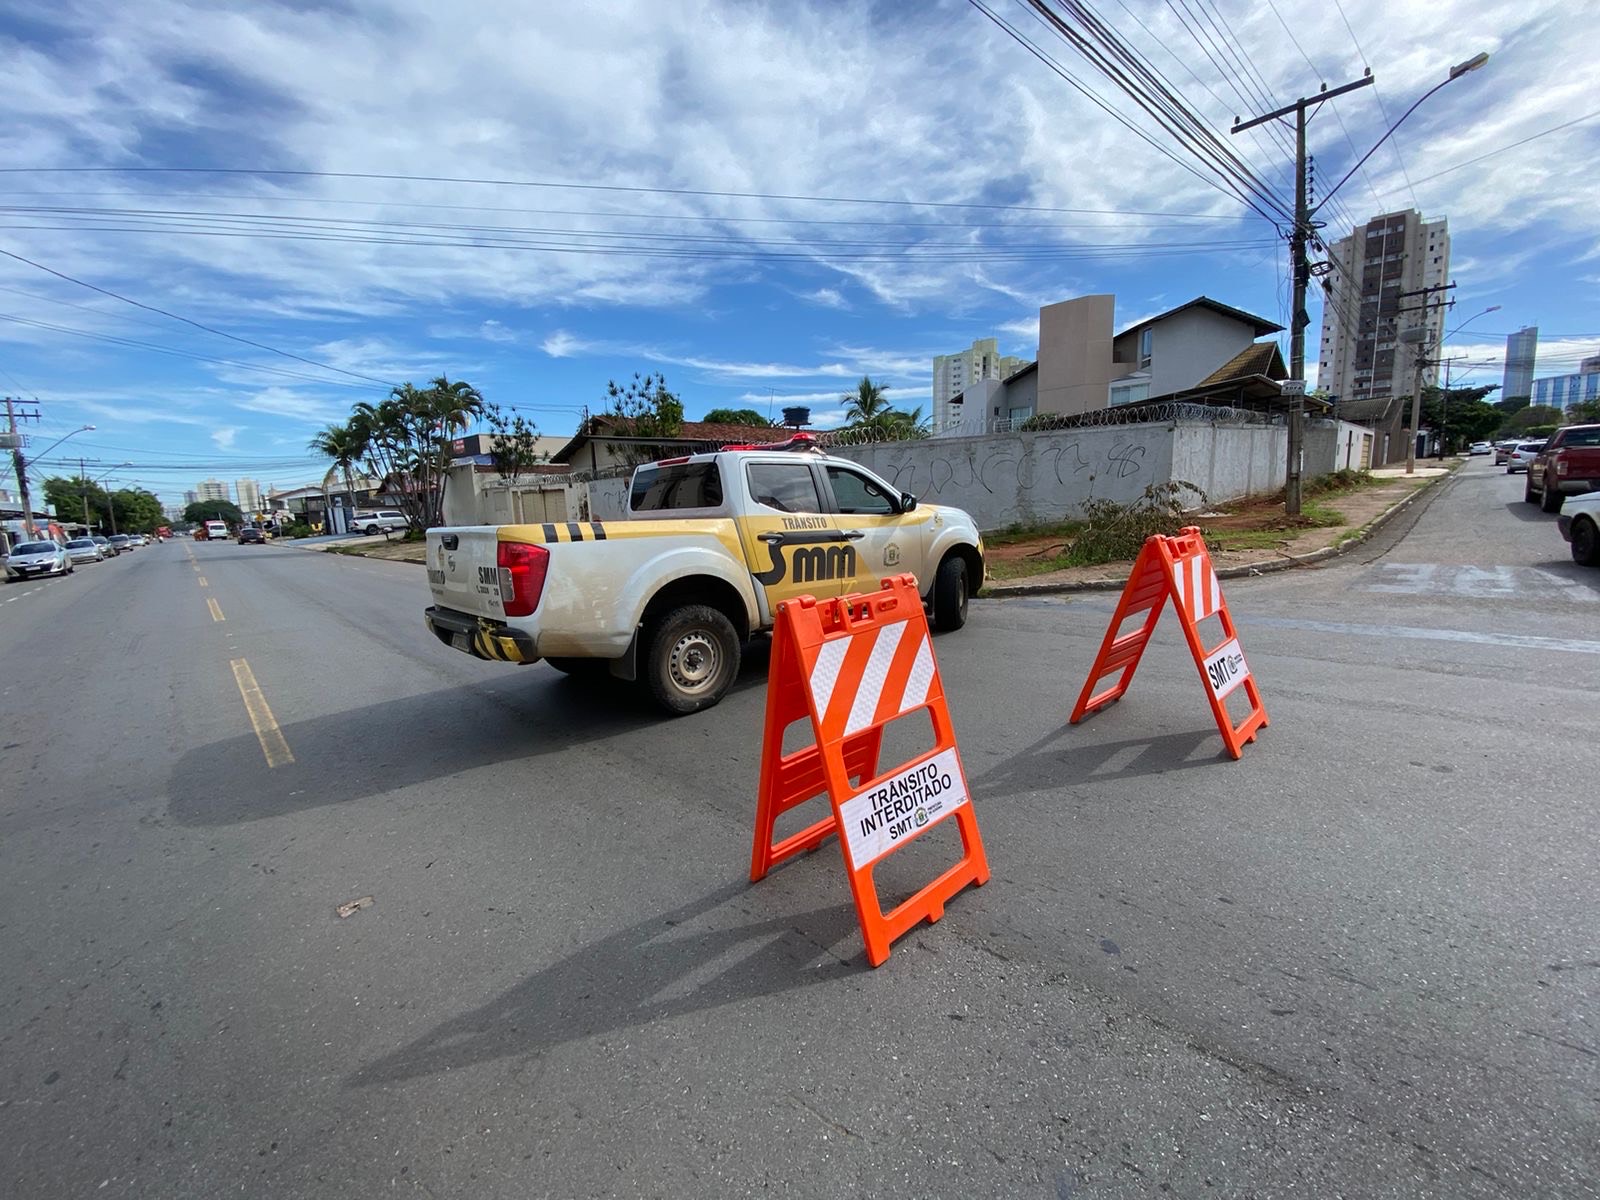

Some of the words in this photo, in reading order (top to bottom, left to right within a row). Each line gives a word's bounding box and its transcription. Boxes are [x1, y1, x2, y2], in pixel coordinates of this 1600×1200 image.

[781, 516, 827, 530] TRÂNSITO
[478, 566, 498, 585] SMM
[1208, 656, 1231, 690] SMT
[868, 763, 938, 811] TRÂNSITO
[860, 773, 952, 837] INTERDITADO
[889, 815, 913, 840] SMT
